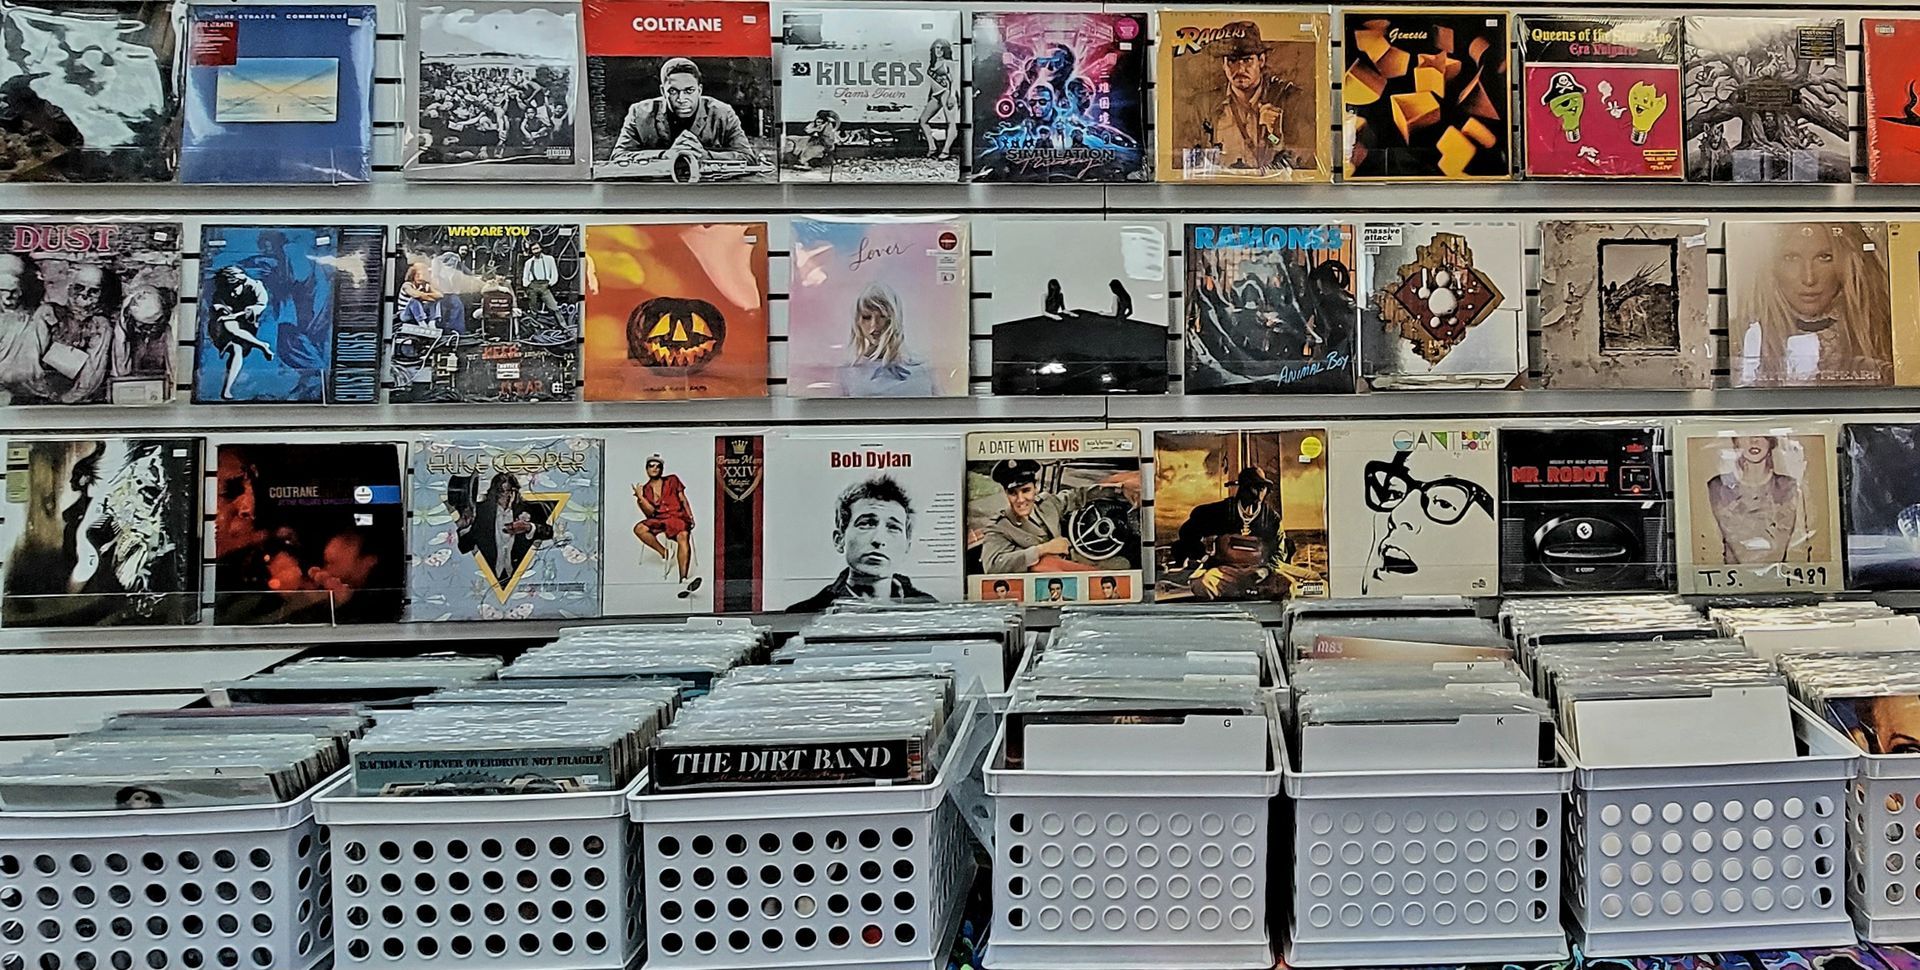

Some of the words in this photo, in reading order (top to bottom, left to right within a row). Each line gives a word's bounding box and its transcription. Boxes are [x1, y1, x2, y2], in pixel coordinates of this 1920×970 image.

[632, 17, 723, 32] COLTRANE
[1172, 27, 1246, 57] RAIDERS
[1389, 28, 1428, 43] Genesis
[1531, 28, 1577, 43] Queens
[1578, 28, 1591, 43] of
[1568, 43, 1590, 56] Era
[816, 61, 925, 86] KILLERS
[872, 87, 906, 99] Town
[1005, 148, 1116, 162] SIMULATION
[14, 225, 119, 252] DUST
[448, 226, 481, 237] WHO
[480, 226, 504, 237] ARE
[504, 226, 530, 237] YOU
[1364, 227, 1400, 235] massive
[1364, 234, 1393, 242] attack
[848, 236, 917, 272] Lover
[336, 332, 378, 362] ROSES
[1277, 363, 1325, 388] ANIMAL
[335, 376, 375, 401] GUNS
[1392, 430, 1460, 451] GIANT
[1461, 431, 1491, 441] BUDDY
[978, 441, 987, 454] A
[989, 440, 1016, 454] DATE
[1018, 440, 1044, 454] WITH
[1049, 439, 1080, 453] ELVIS
[1461, 440, 1492, 451] HOLLY
[492, 450, 589, 475] COOPER
[830, 451, 863, 468] Bob
[866, 451, 912, 469] Dylan
[723, 466, 757, 478] XXIV
[1511, 466, 1543, 483] MR.
[1547, 466, 1609, 483] ROBOT
[269, 486, 320, 498] COLTRANE
[1580, 525, 1590, 536] E
[1698, 570, 1742, 587] T.S.
[1786, 566, 1827, 587] 1989
[1317, 640, 1343, 653] M83
[1223, 719, 1231, 727] G
[1496, 717, 1504, 725] K
[465, 757, 528, 769] OVERDRIVE
[531, 757, 554, 766] NOT
[556, 754, 604, 766] FRAGILE
[672, 752, 732, 774] THE
[738, 750, 808, 773] DIRT
[813, 747, 892, 770] BAND
[214, 767, 223, 775] A
